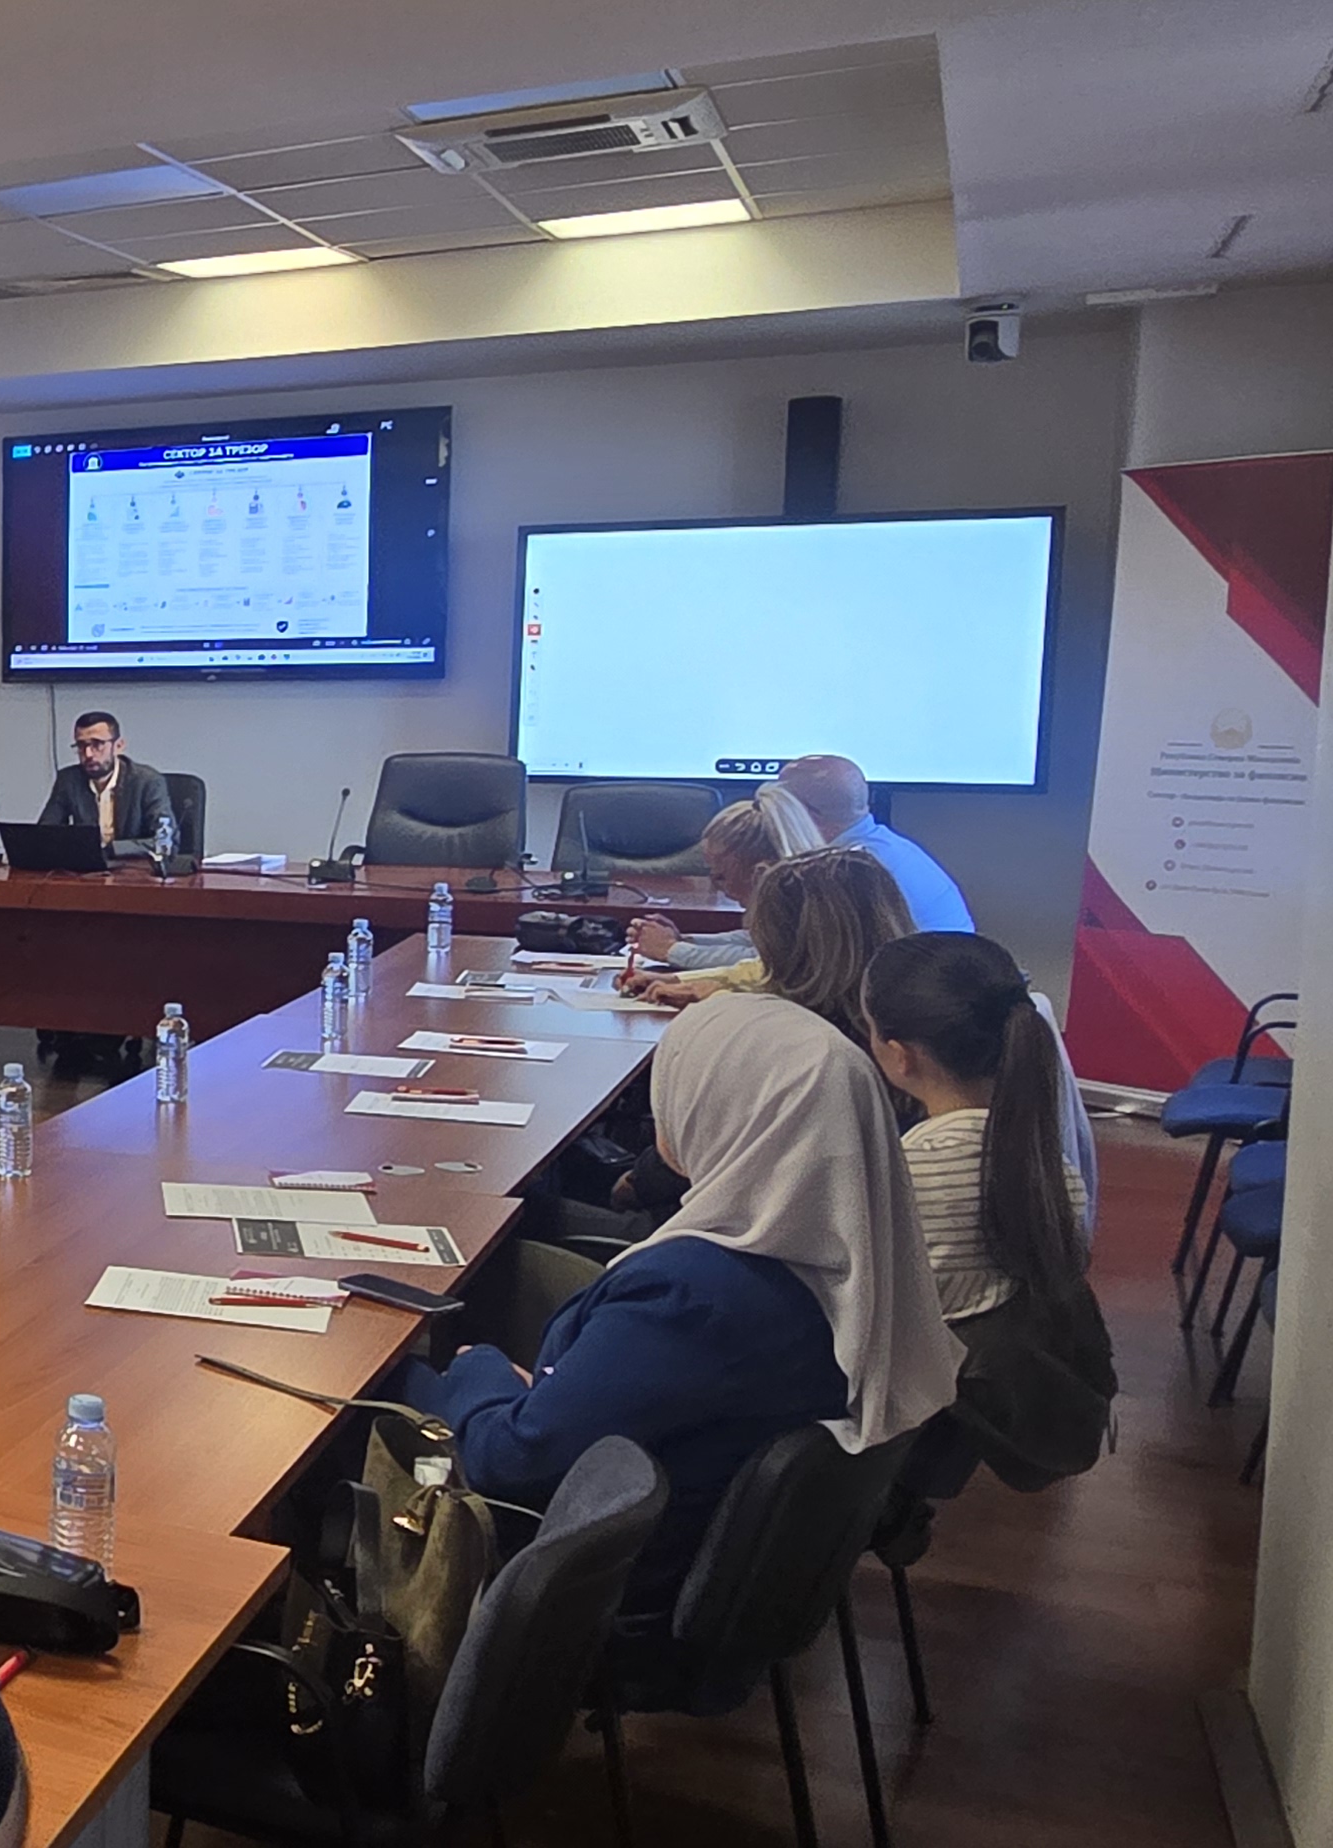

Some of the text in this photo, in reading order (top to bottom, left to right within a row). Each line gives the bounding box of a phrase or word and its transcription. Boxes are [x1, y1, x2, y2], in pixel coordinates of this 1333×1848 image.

[163, 447, 207, 460] СЕКТОР
[208, 446, 223, 457] ЗА
[225, 444, 269, 456] ТРЕЗОР
